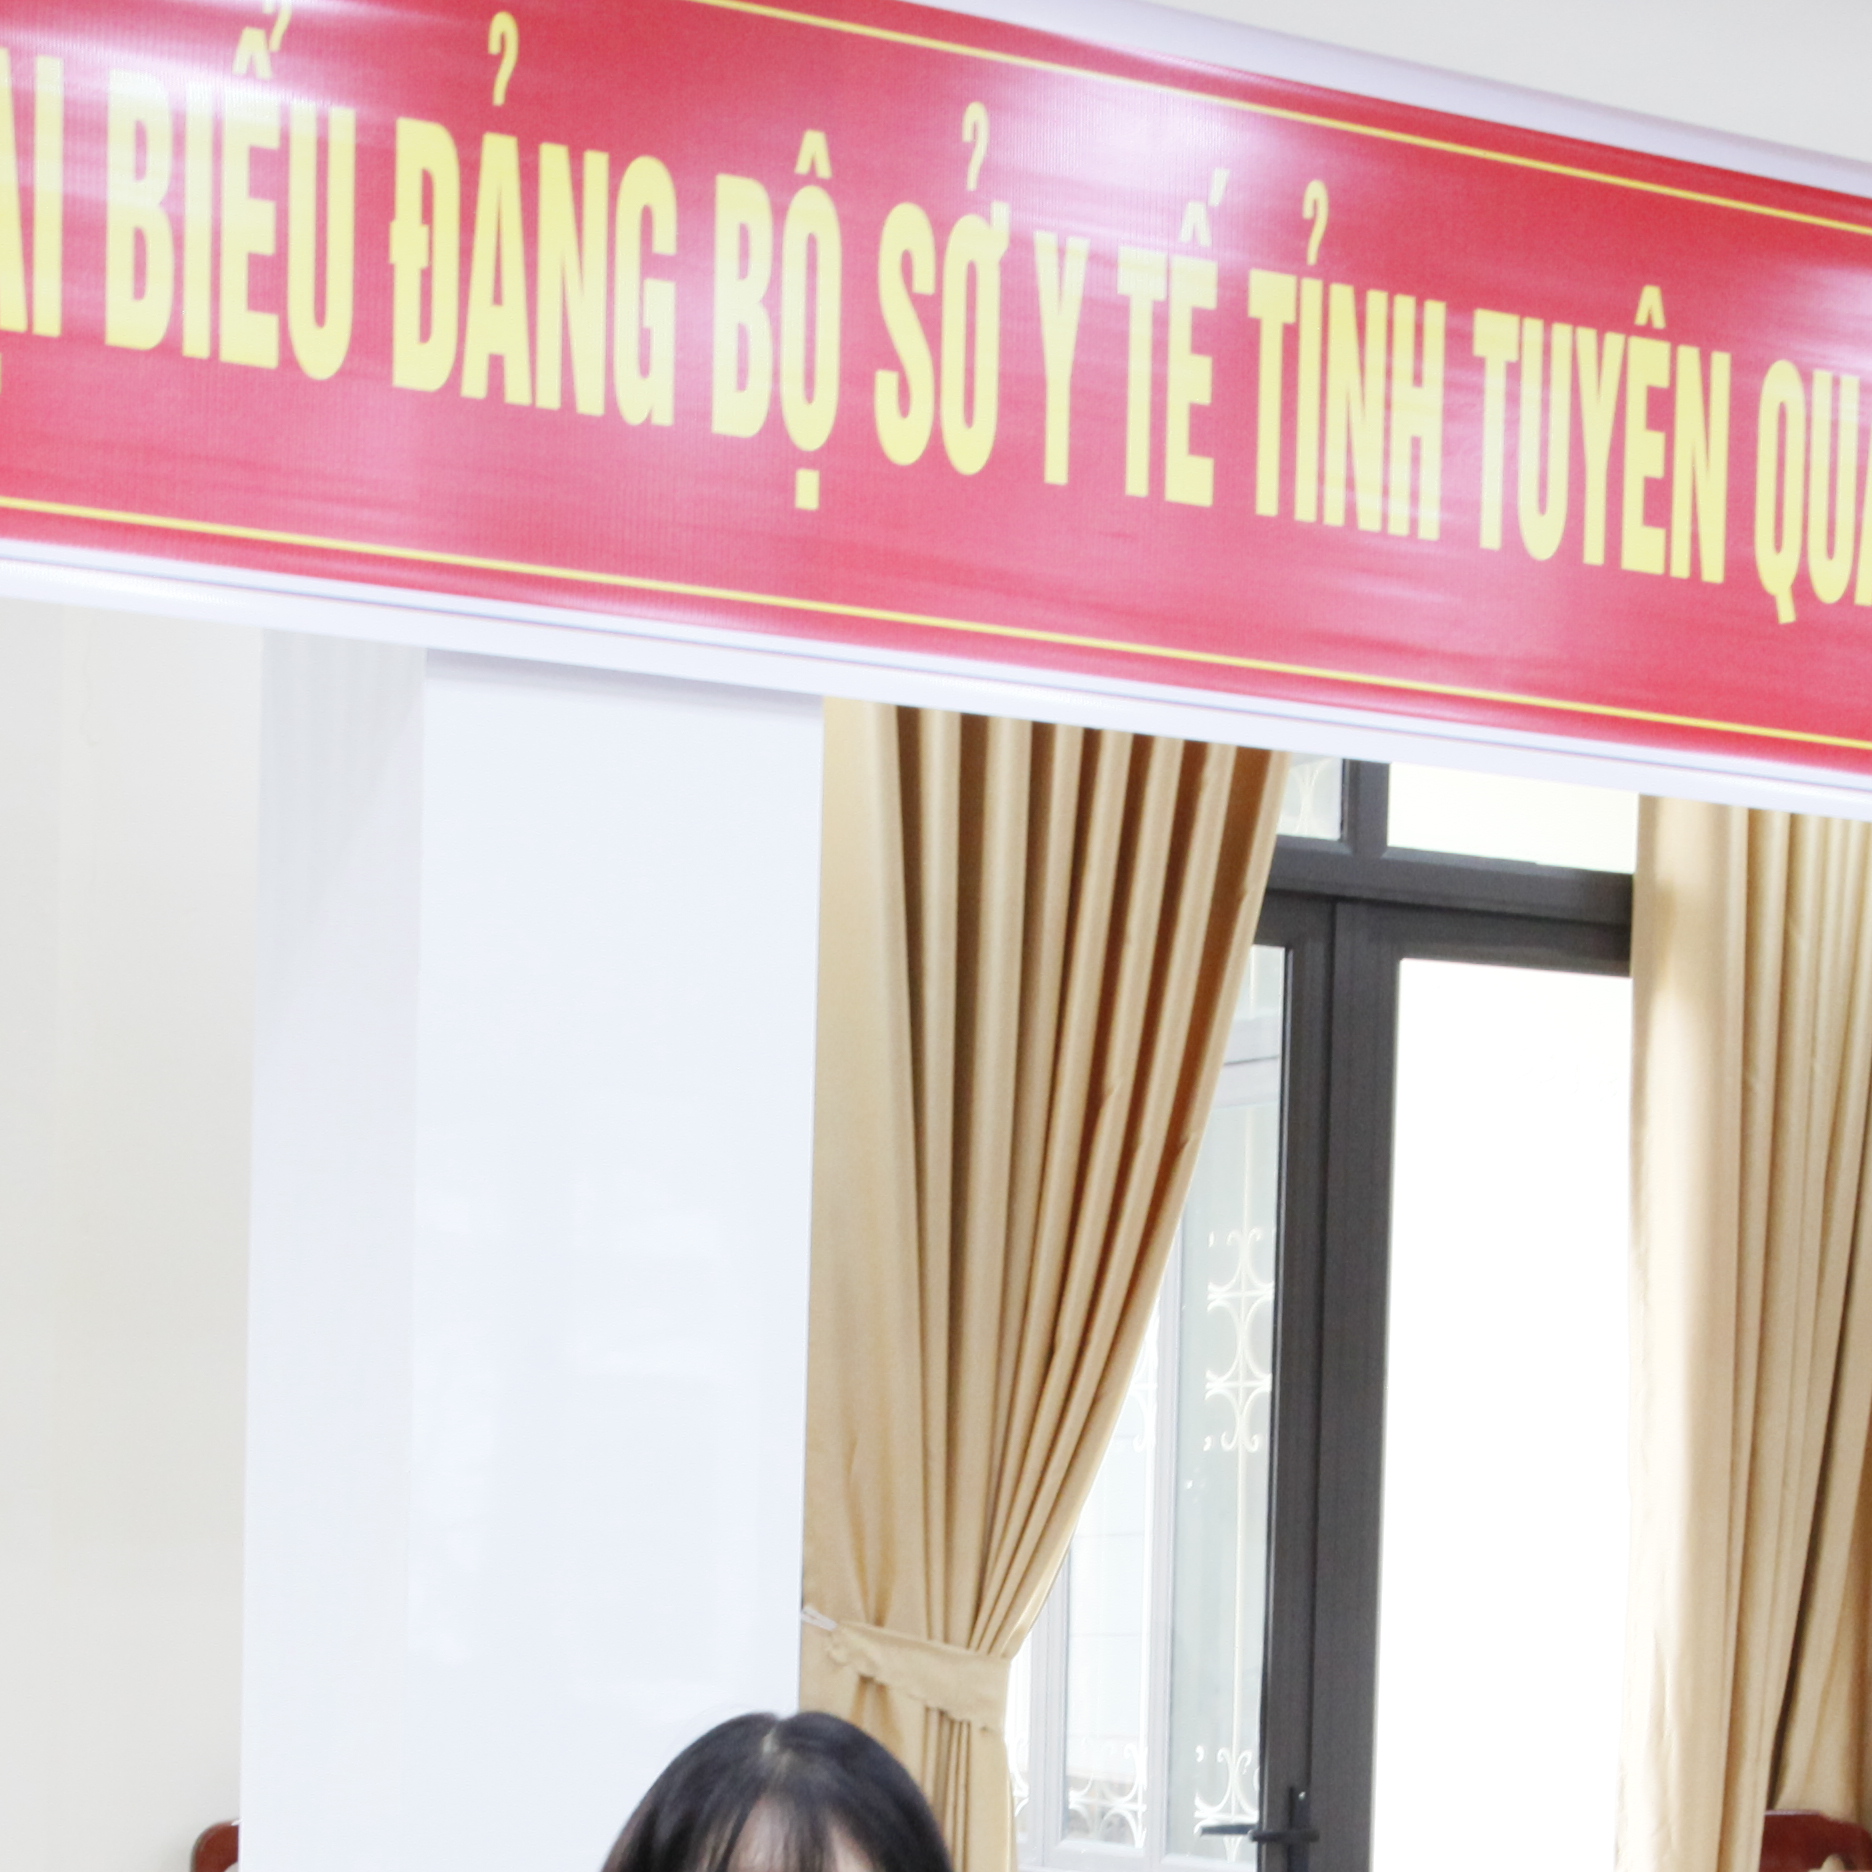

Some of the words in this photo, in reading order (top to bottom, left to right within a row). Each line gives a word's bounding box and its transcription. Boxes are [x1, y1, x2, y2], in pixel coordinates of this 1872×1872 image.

[105, 0, 357, 380] BIỂU
[389, 12, 677, 427] ĐẢNG
[711, 130, 841, 511] BỘ
[874, 101, 1010, 475] SỞ
[1033, 231, 1091, 486] Y
[1116, 168, 1228, 508] TẾ
[1247, 180, 1447, 541] TỈNH
[1472, 284, 1732, 584] TUYÊN
